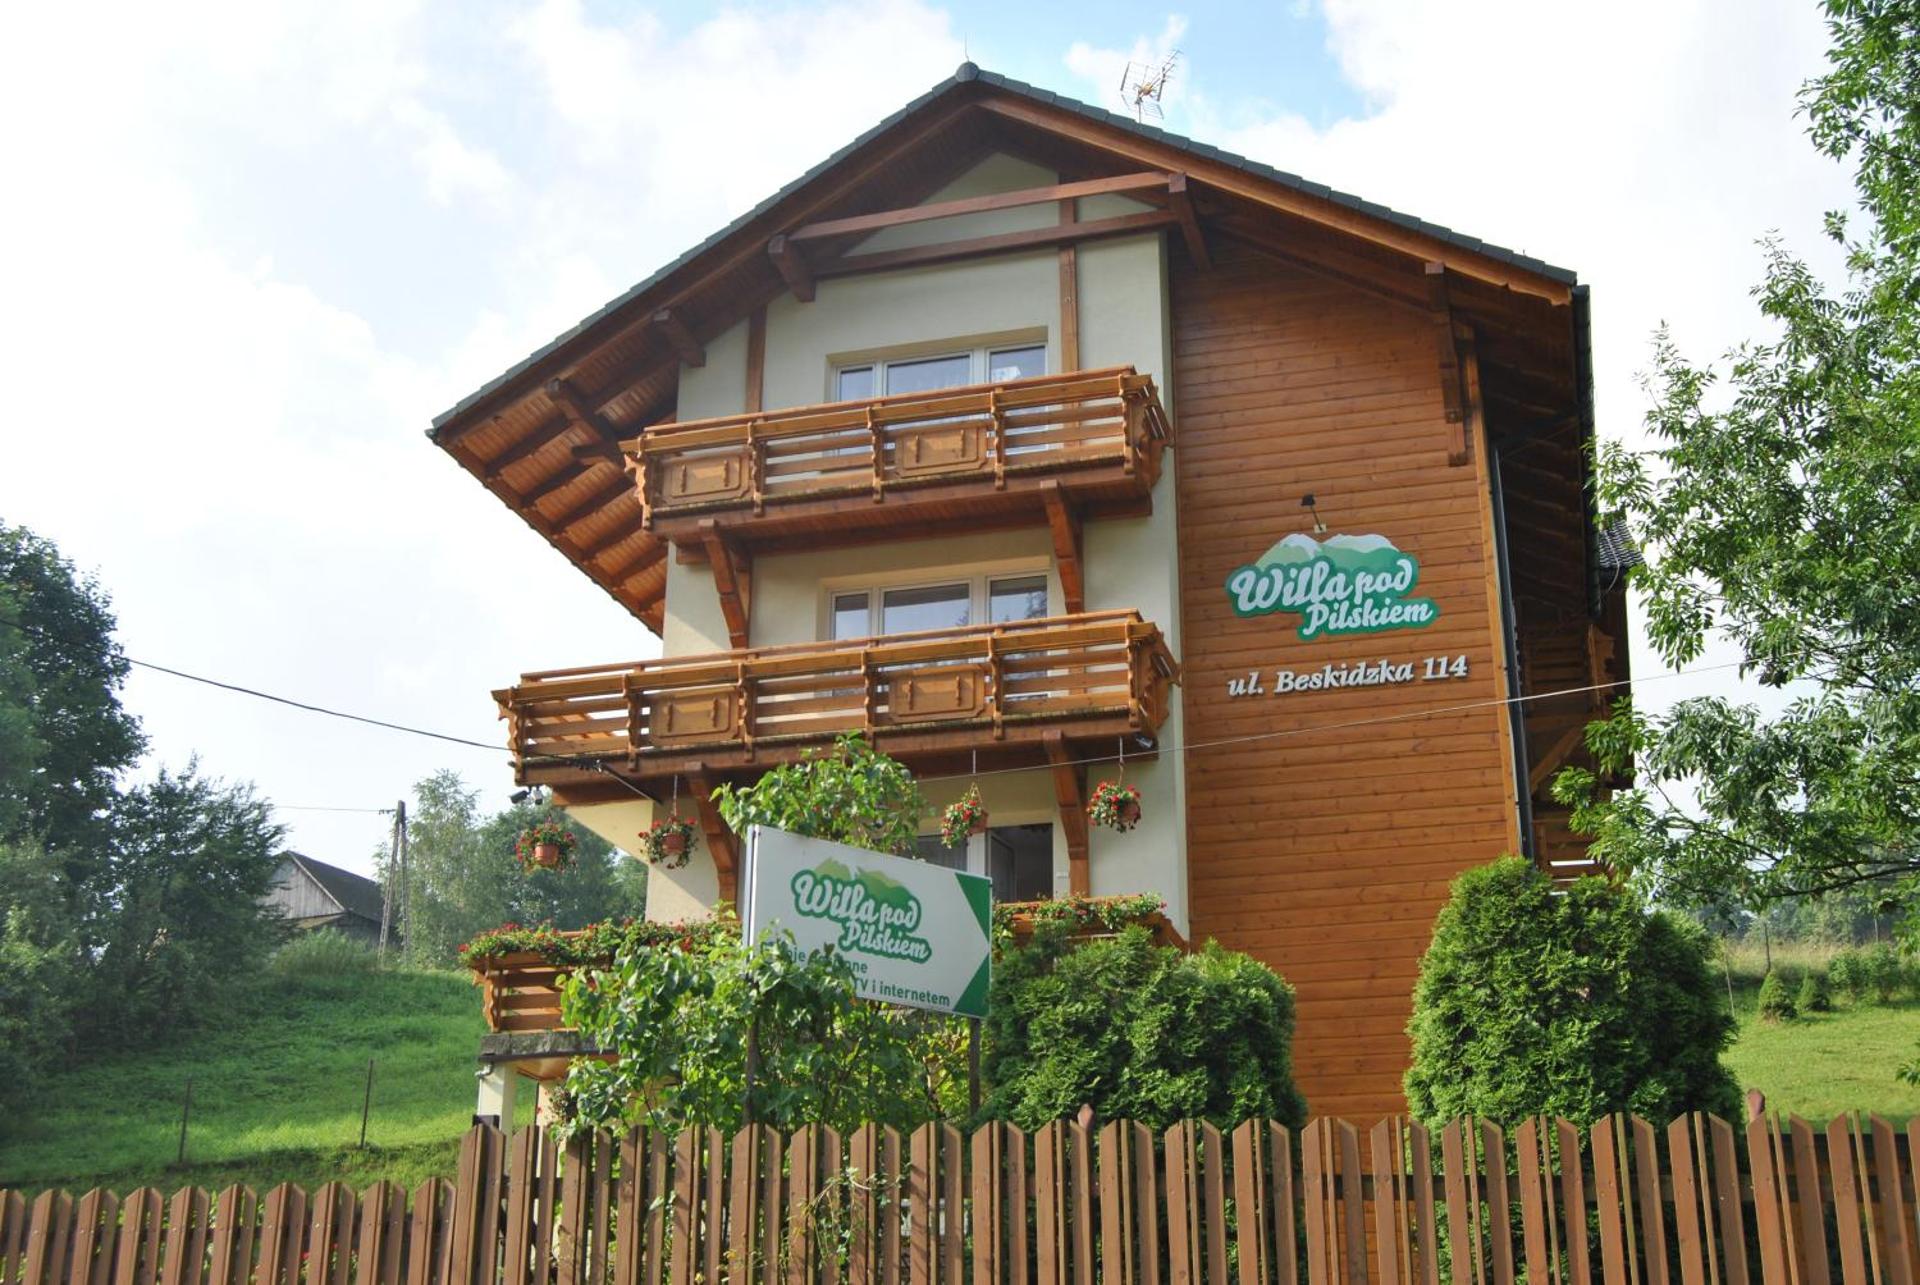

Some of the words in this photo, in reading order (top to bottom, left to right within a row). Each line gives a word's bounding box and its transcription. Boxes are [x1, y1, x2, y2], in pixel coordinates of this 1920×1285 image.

[1231, 560, 1352, 611] Willa
[1355, 559, 1413, 602] pod
[1302, 598, 1433, 635] Pilskiem
[1227, 671, 1264, 697] ul.
[1273, 659, 1414, 694] Beskidzka
[1422, 654, 1468, 681] 114
[794, 874, 880, 922] Willa
[880, 901, 919, 929] pod
[843, 922, 929, 958] Pilskiem
[872, 979, 877, 994] i
[879, 980, 950, 1006] internetem
